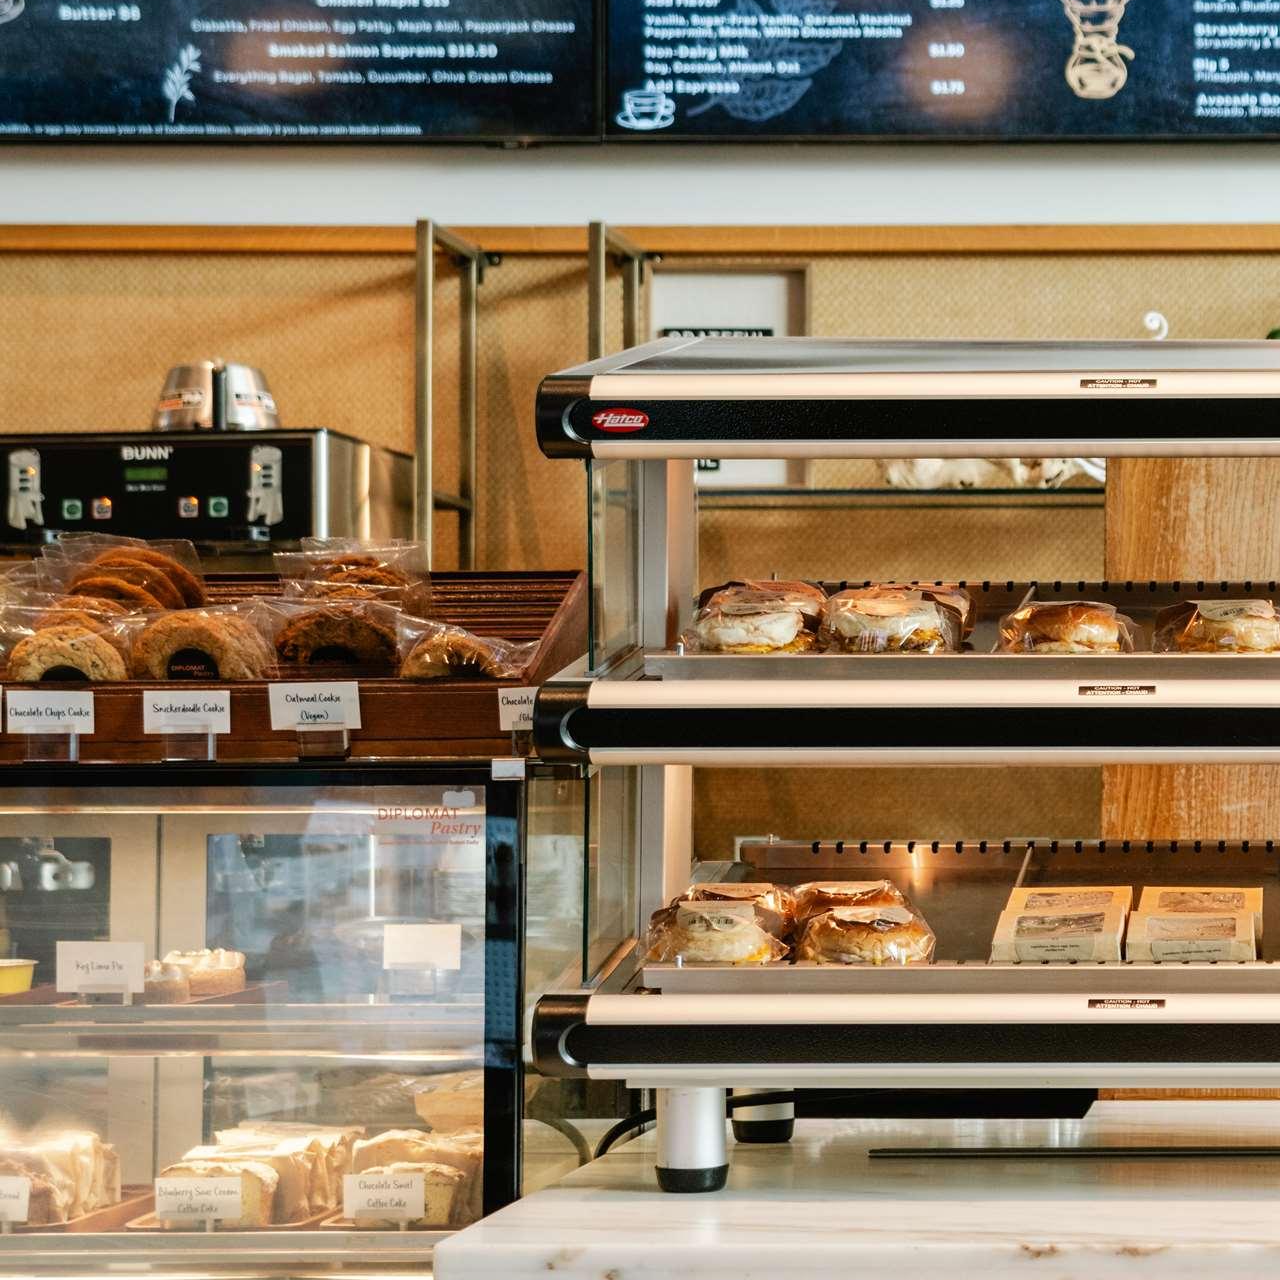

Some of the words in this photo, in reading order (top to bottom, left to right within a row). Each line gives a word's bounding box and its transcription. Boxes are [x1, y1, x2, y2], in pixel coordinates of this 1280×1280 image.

[594, 412, 644, 427] Hatco
[121, 446, 170, 460] BUNN
[378, 807, 460, 820] DIPLOMAT
[431, 821, 480, 835] Pastry
